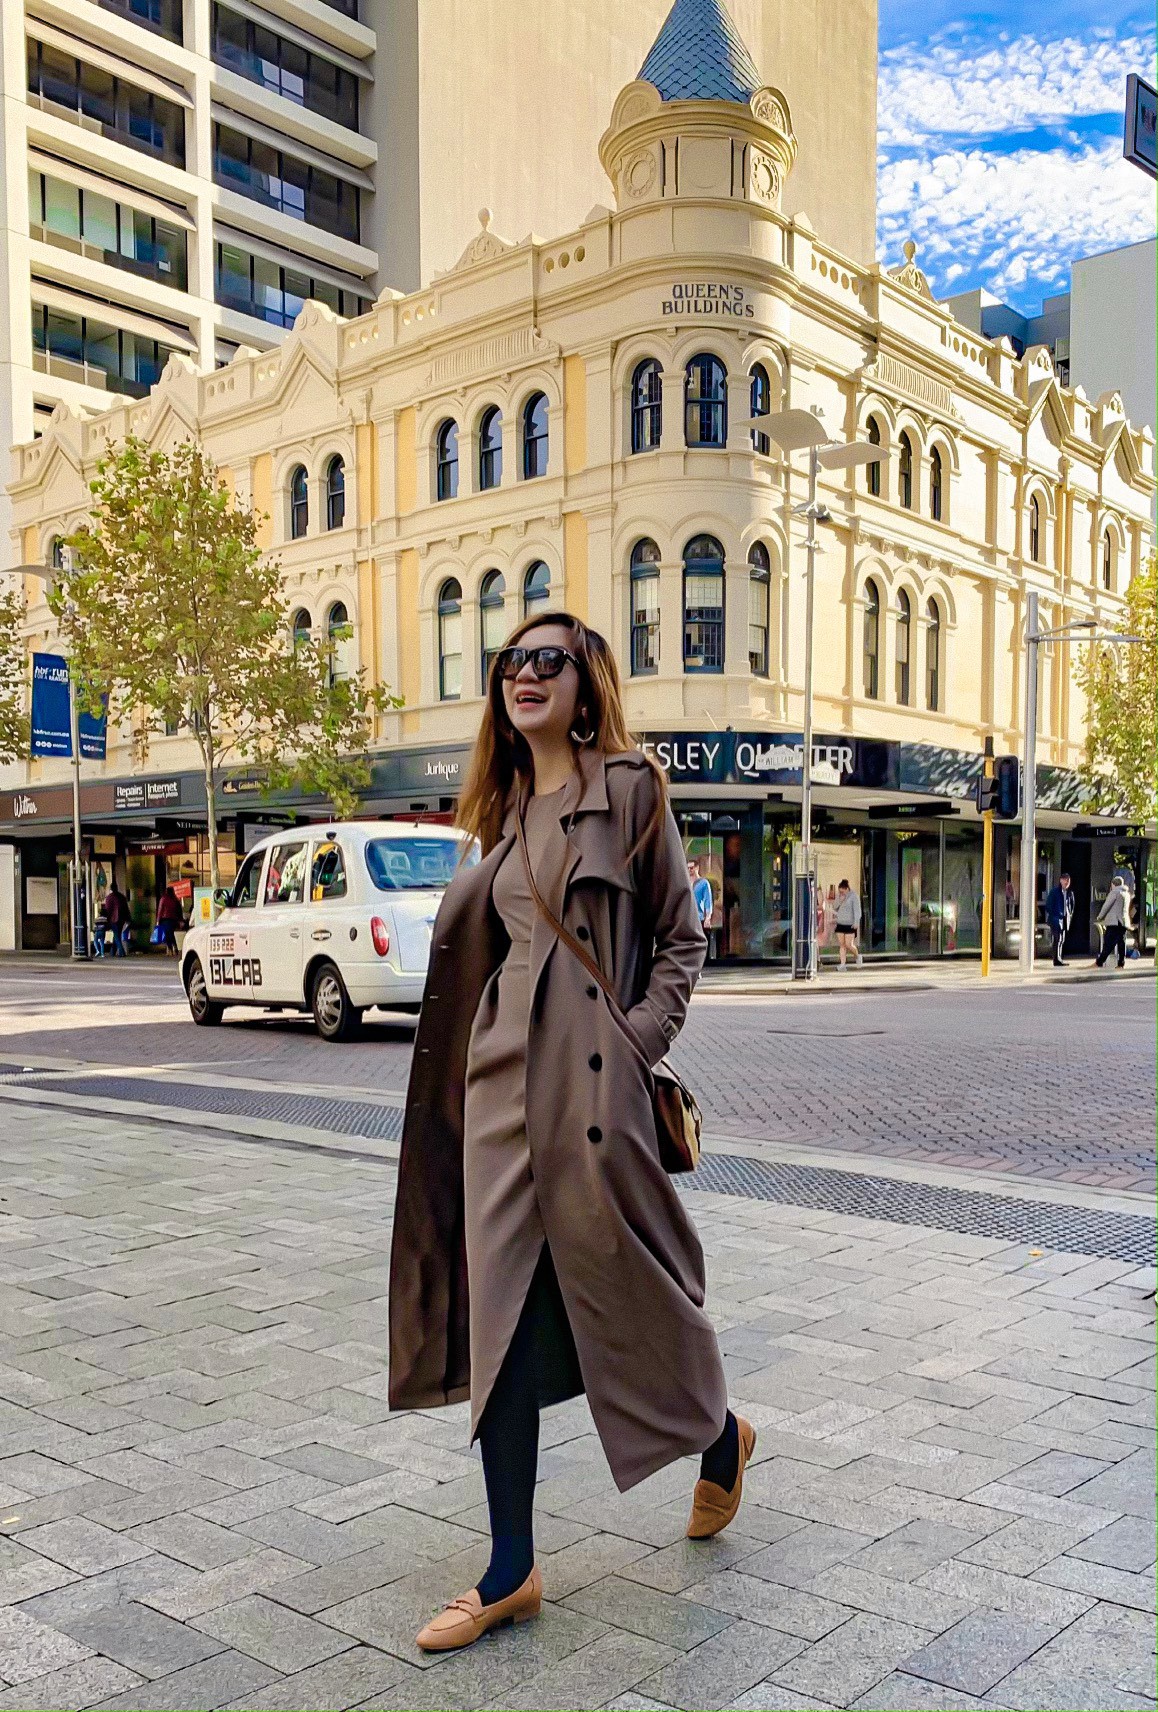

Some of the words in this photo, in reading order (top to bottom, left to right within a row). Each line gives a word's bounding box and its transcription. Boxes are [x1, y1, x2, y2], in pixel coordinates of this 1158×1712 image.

[672, 284, 744, 301] QUEEN'S
[662, 300, 754, 317] BUILDINGS
[52, 669, 68, 678] run
[636, 742, 720, 770] ESLEY
[425, 761, 459, 781] Jurlique
[117, 785, 143, 797] Repairs
[147, 782, 177, 793] Internet
[222, 938, 234, 951] 222
